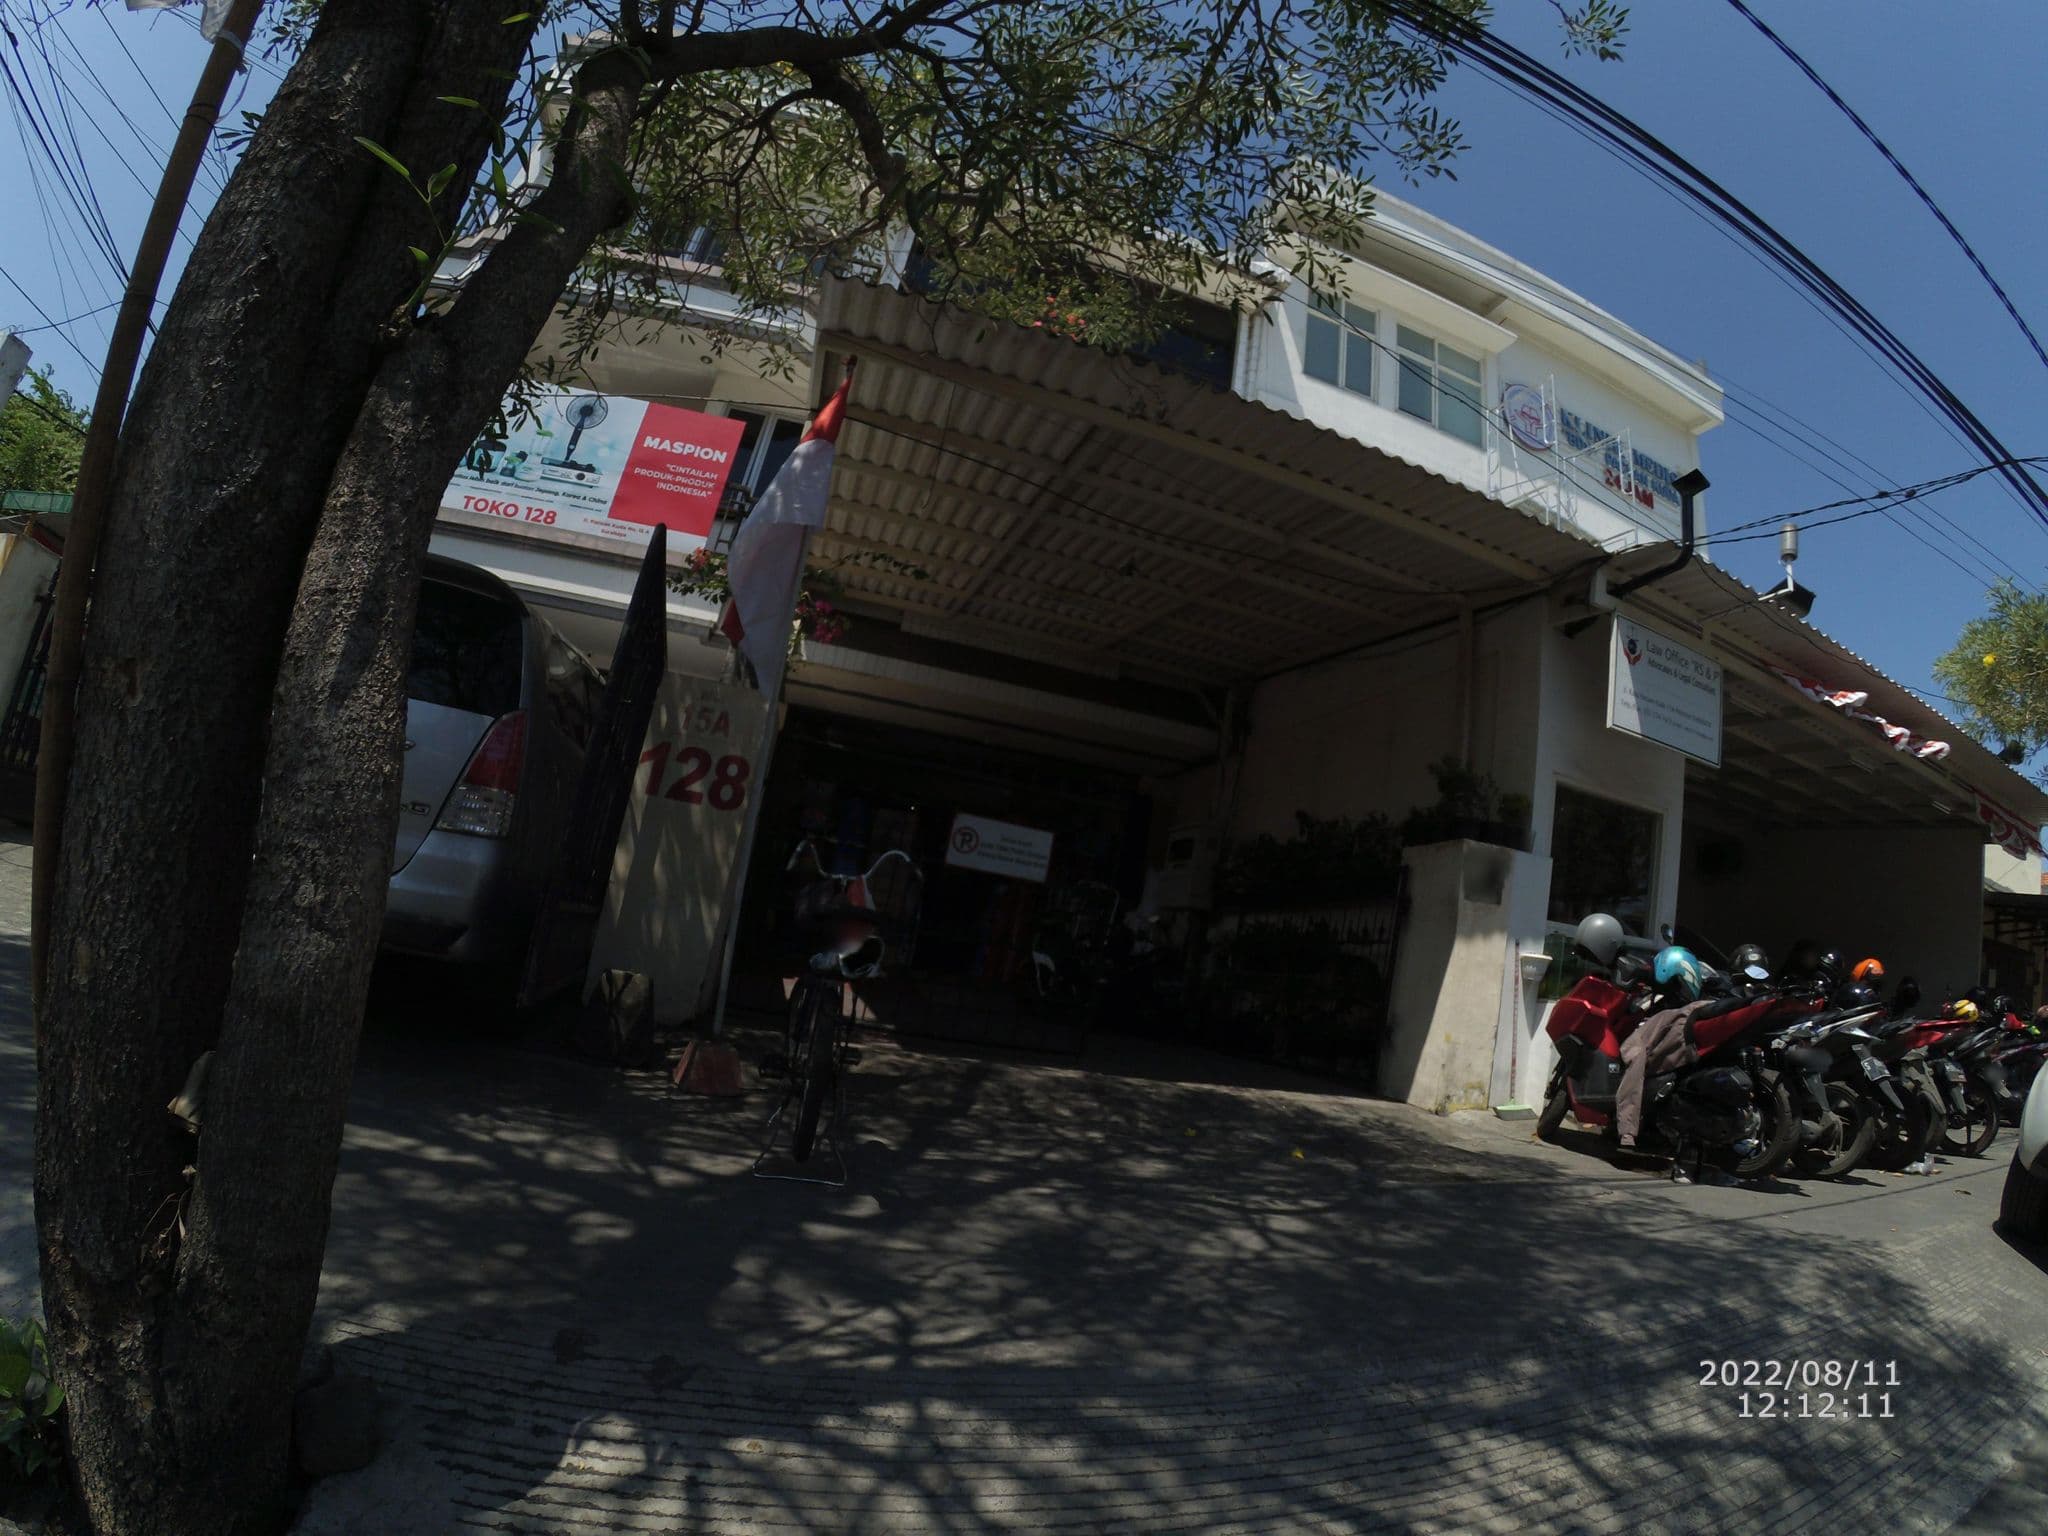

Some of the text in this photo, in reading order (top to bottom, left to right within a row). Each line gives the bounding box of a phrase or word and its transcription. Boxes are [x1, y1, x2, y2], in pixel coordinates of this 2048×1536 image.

[643, 435, 727, 464] MASPION
[634, 467, 716, 488] PRODUK-PRODUK
[666, 463, 719, 480] "CINTAILAH
[561, 491, 581, 500] Korea
[588, 496, 608, 505] China
[656, 481, 712, 498] INDONESIA"
[463, 495, 519, 518] TOKO
[524, 506, 558, 525] 128
[1646, 639, 1664, 656] Law
[1665, 648, 1690, 669] Office
[682, 703, 730, 738] 15A
[640, 741, 750, 811] 128
